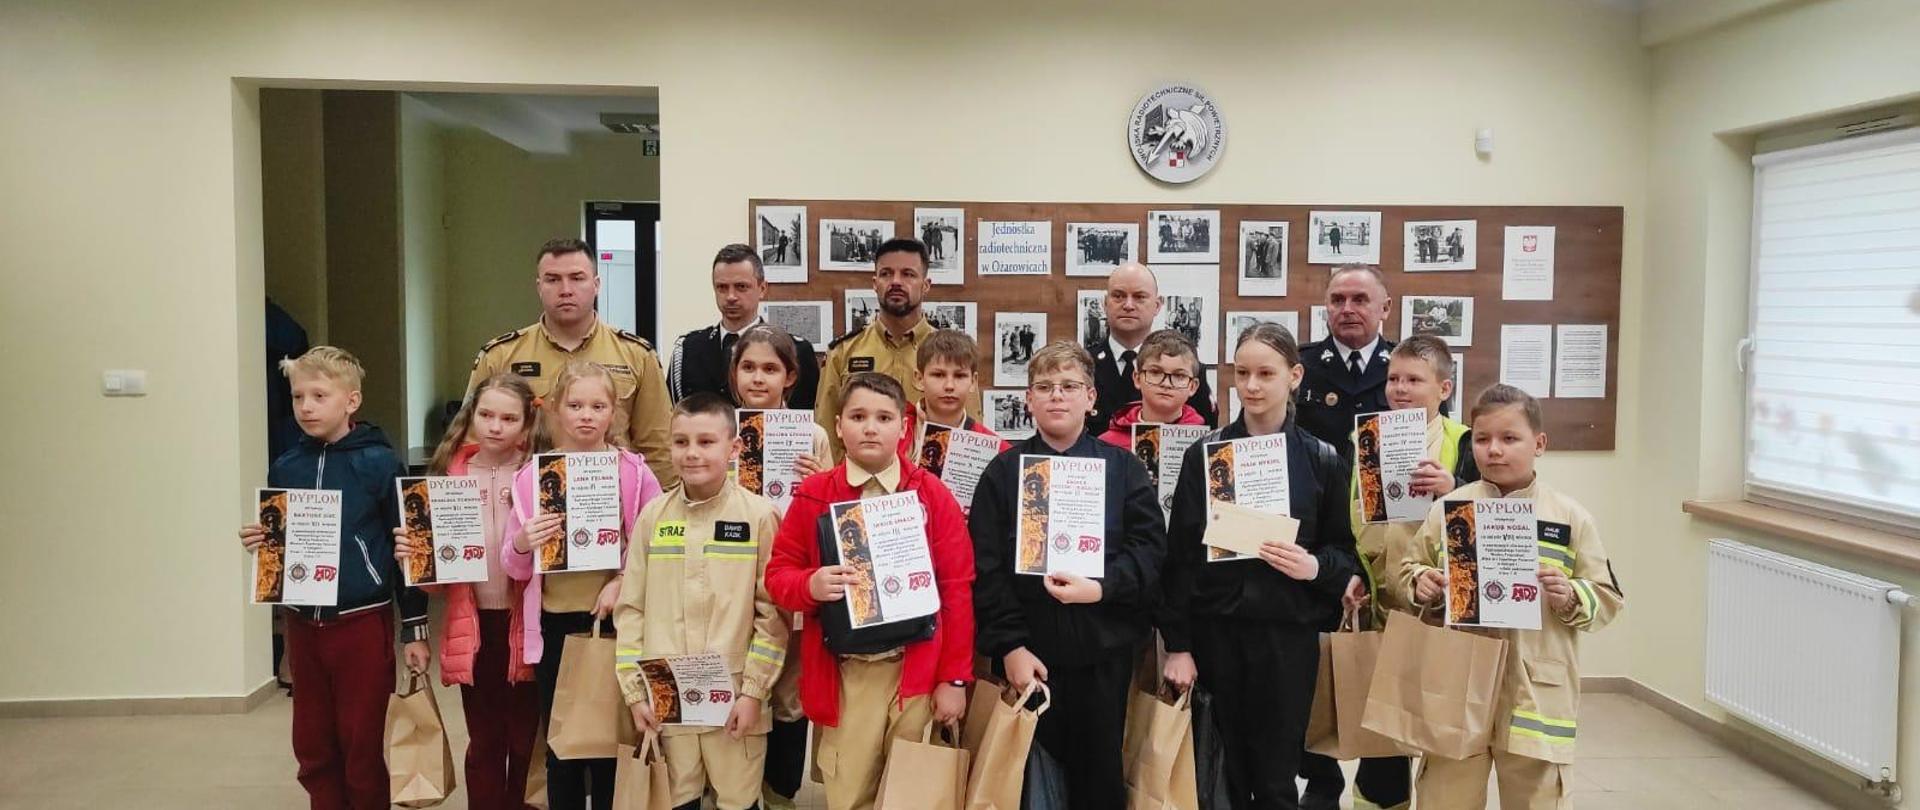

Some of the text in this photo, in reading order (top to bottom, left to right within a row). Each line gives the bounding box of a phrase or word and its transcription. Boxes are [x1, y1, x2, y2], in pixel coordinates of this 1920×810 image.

[1135, 86, 1194, 126] RADIOTECHNICZNE
[1134, 128, 1148, 161] WOJSKA
[991, 222, 1036, 238] Jednostka
[979, 241, 1048, 254] radiotechniczna
[982, 263, 990, 272] w
[766, 412, 812, 424] DYPLOM
[1381, 411, 1425, 425] DYPLOM
[952, 431, 999, 450] DYPLOM
[1235, 437, 1283, 454] DYPLOM
[568, 454, 617, 467] DYPLOM
[1052, 460, 1103, 473] DYPLOM
[430, 479, 479, 490] DYPLOM
[289, 493, 340, 505] DYPLOM
[864, 495, 917, 514] DYPLOM
[1477, 502, 1534, 514] DYPLOM
[724, 524, 743, 532] DAWID
